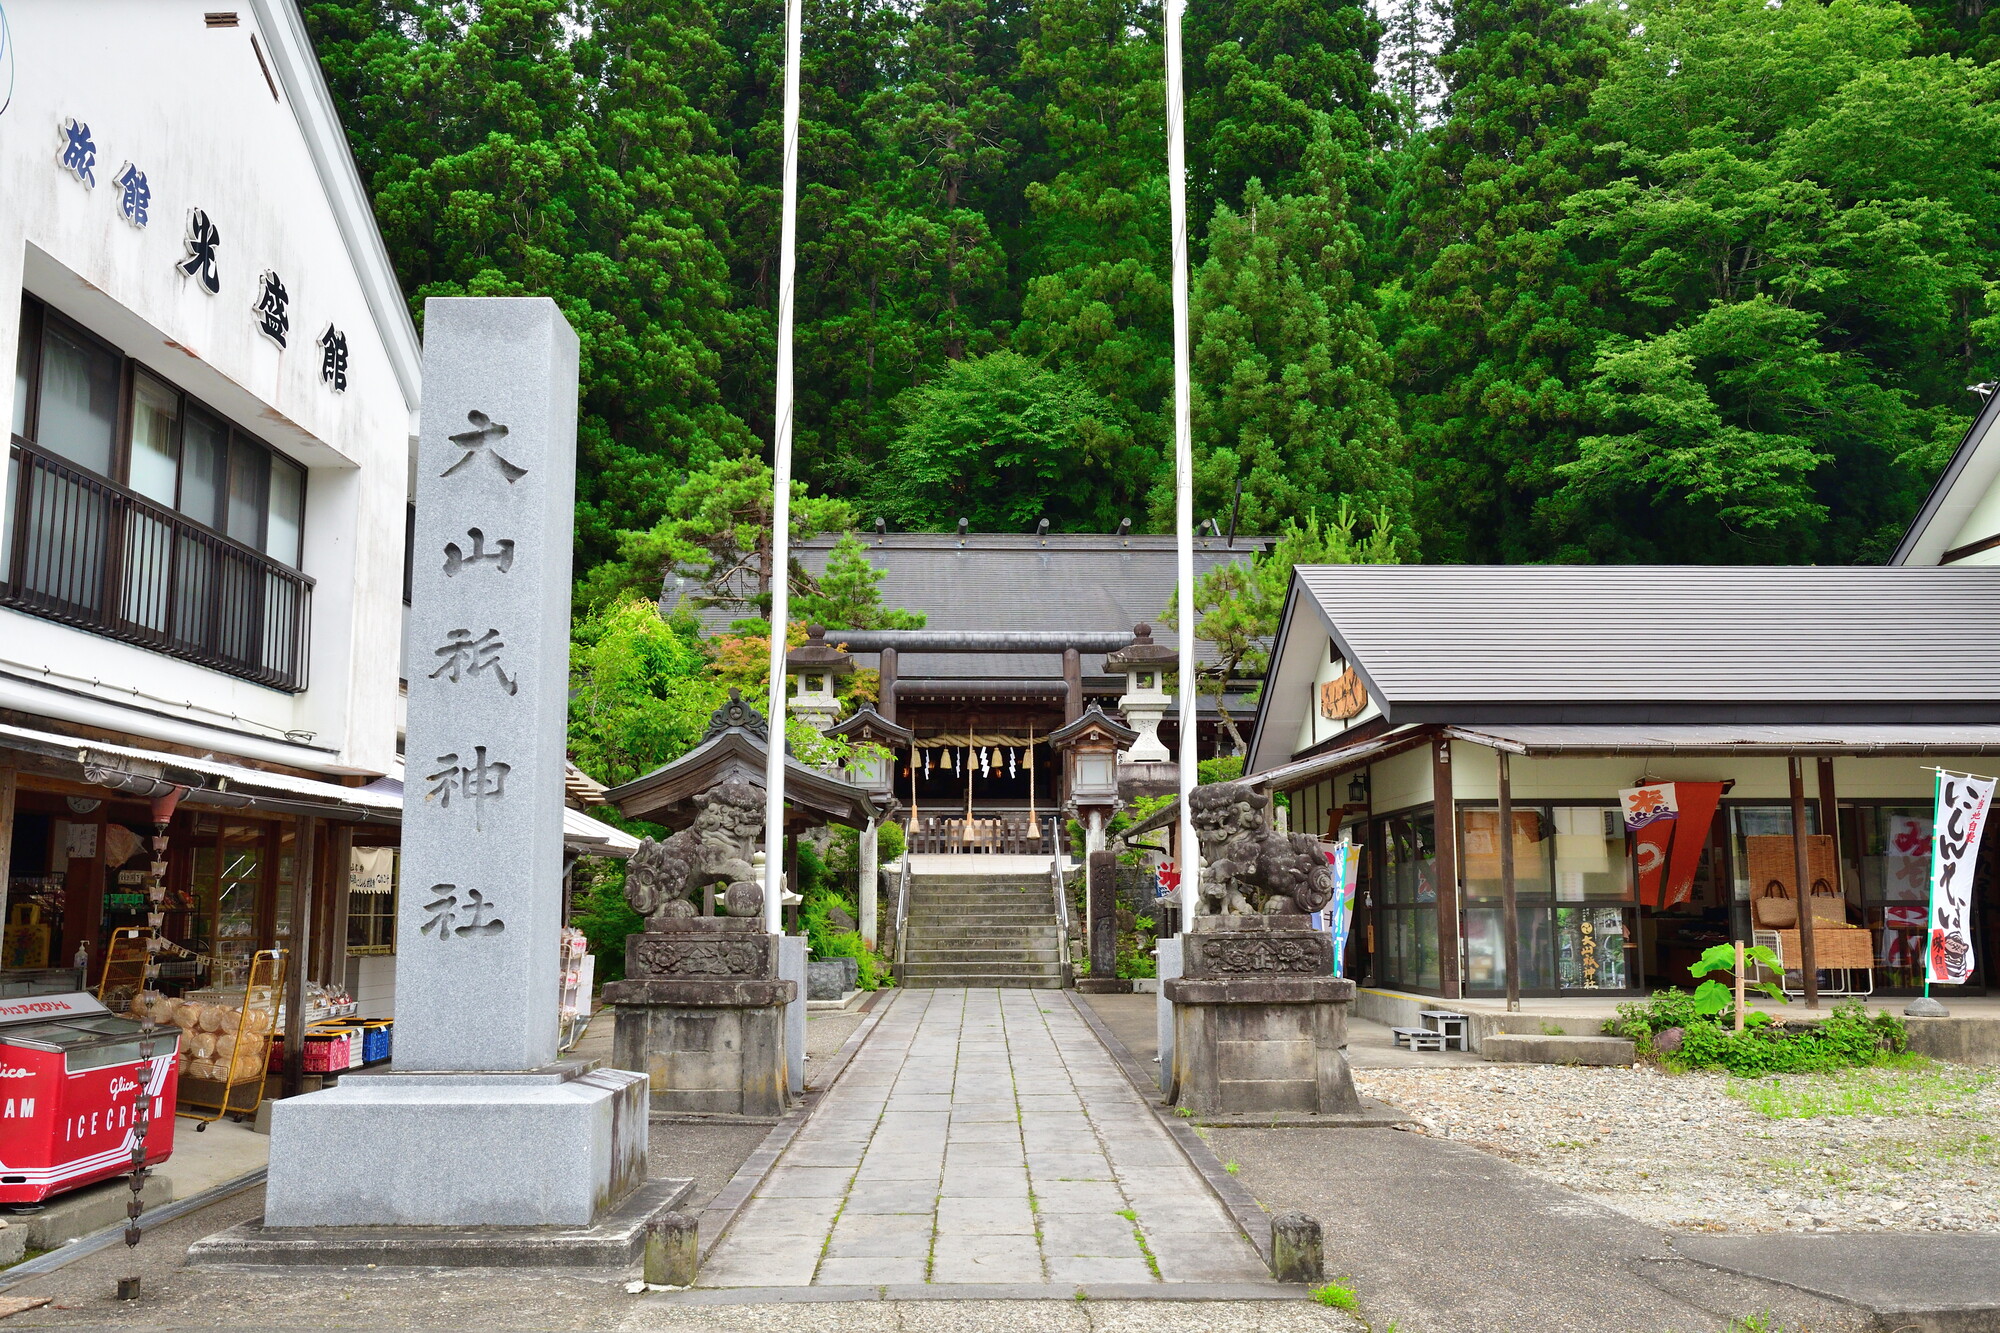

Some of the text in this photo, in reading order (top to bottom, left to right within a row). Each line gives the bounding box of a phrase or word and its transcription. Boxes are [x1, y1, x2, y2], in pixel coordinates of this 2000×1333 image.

[60, 117, 349, 394] 旅館 光盛館
[420, 409, 529, 942] 大山祇神社
[66, 1112, 99, 1142] ICE
[109, 1076, 139, 1101] Glico
